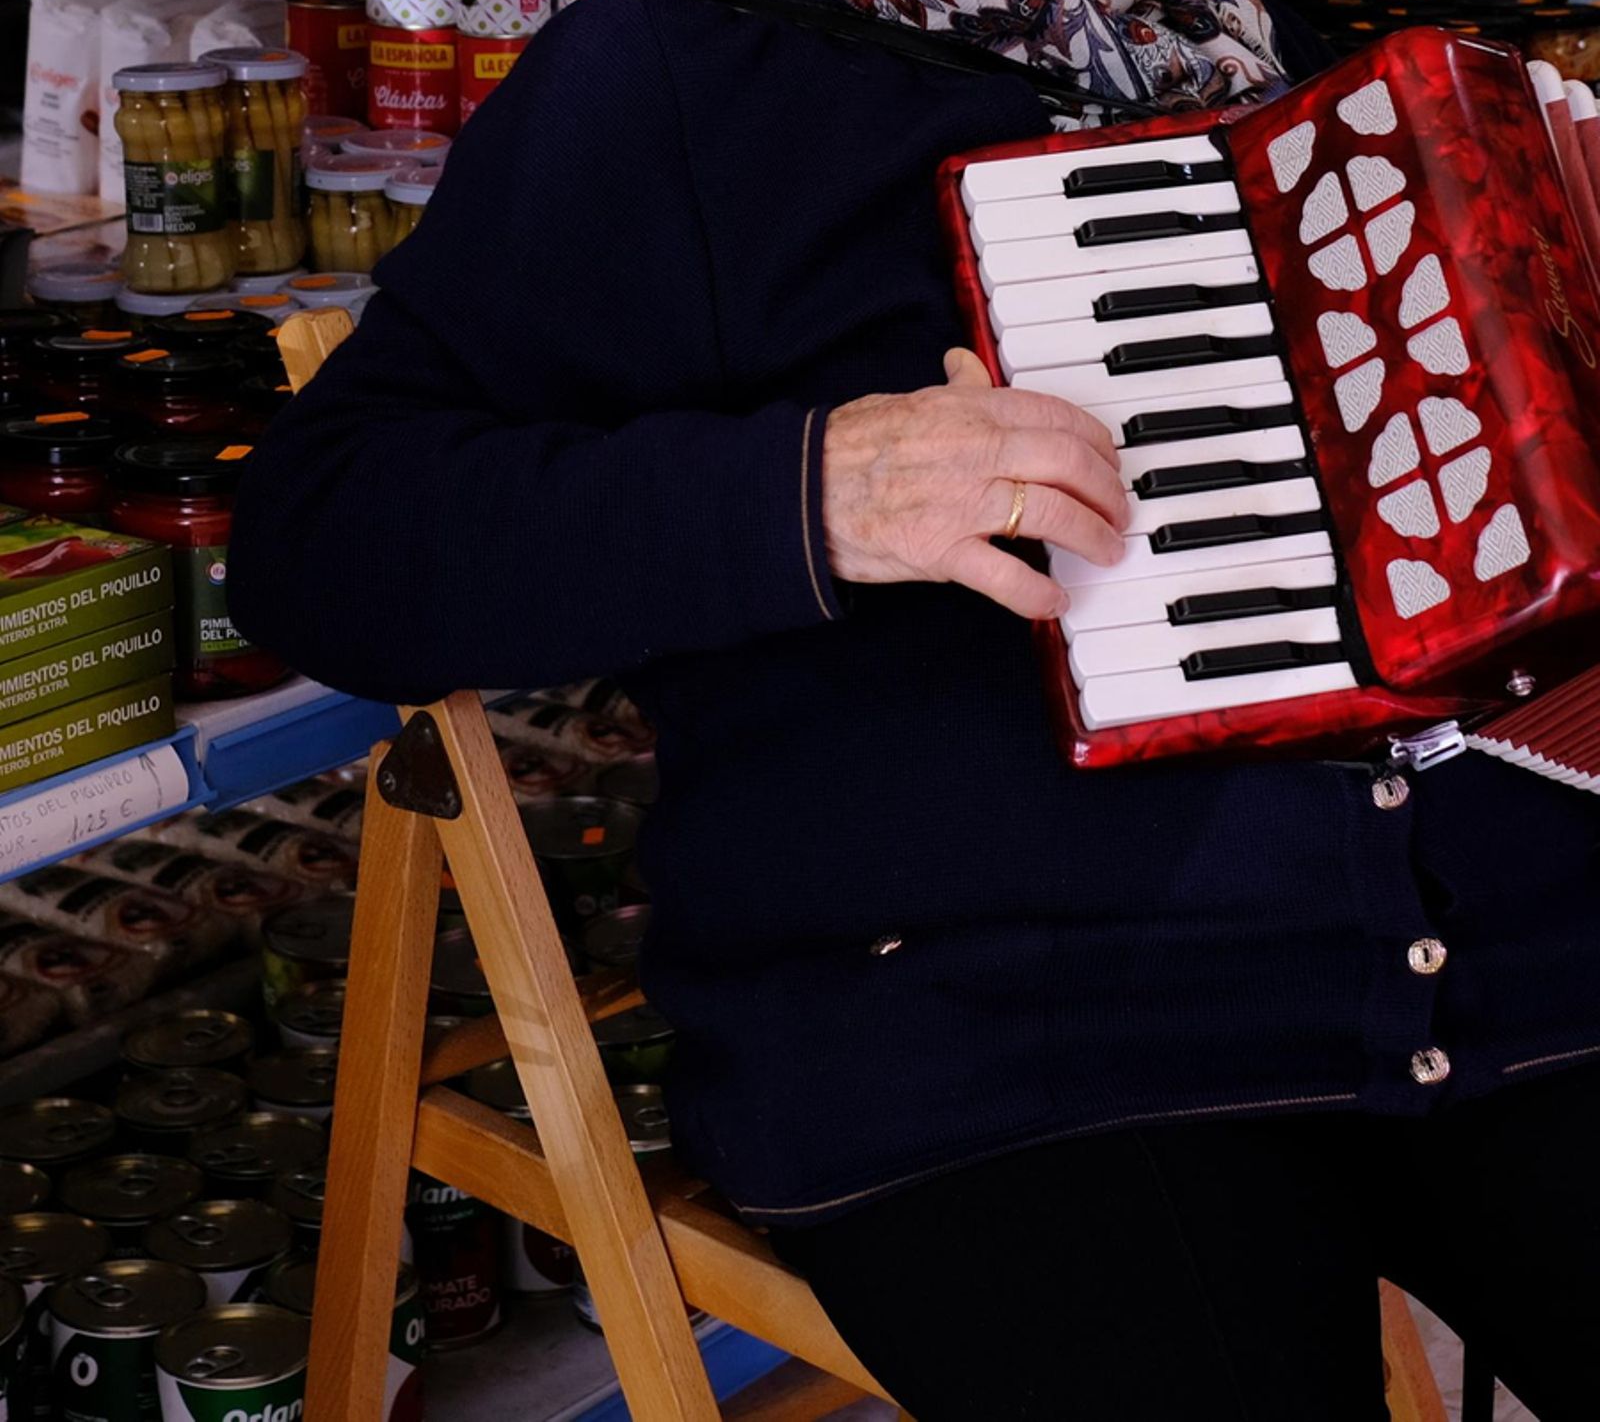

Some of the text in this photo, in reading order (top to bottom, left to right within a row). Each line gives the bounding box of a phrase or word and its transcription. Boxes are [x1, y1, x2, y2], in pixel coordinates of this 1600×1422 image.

[386, 45, 448, 64] ESPAÑOLA
[481, 57, 495, 73] LA
[373, 85, 447, 110] Clásicas
[71, 588, 98, 610] DEL
[100, 565, 162, 600] PIQUILLO
[38, 614, 69, 635] EXTRA
[201, 629, 224, 641] DEL
[72, 649, 99, 673] DEL
[102, 628, 163, 663] PIQUILLO
[39, 677, 70, 698] EXTRA
[66, 718, 94, 740] DEL
[97, 695, 161, 730] PIQUILLO
[33, 745, 65, 765] EXTRA
